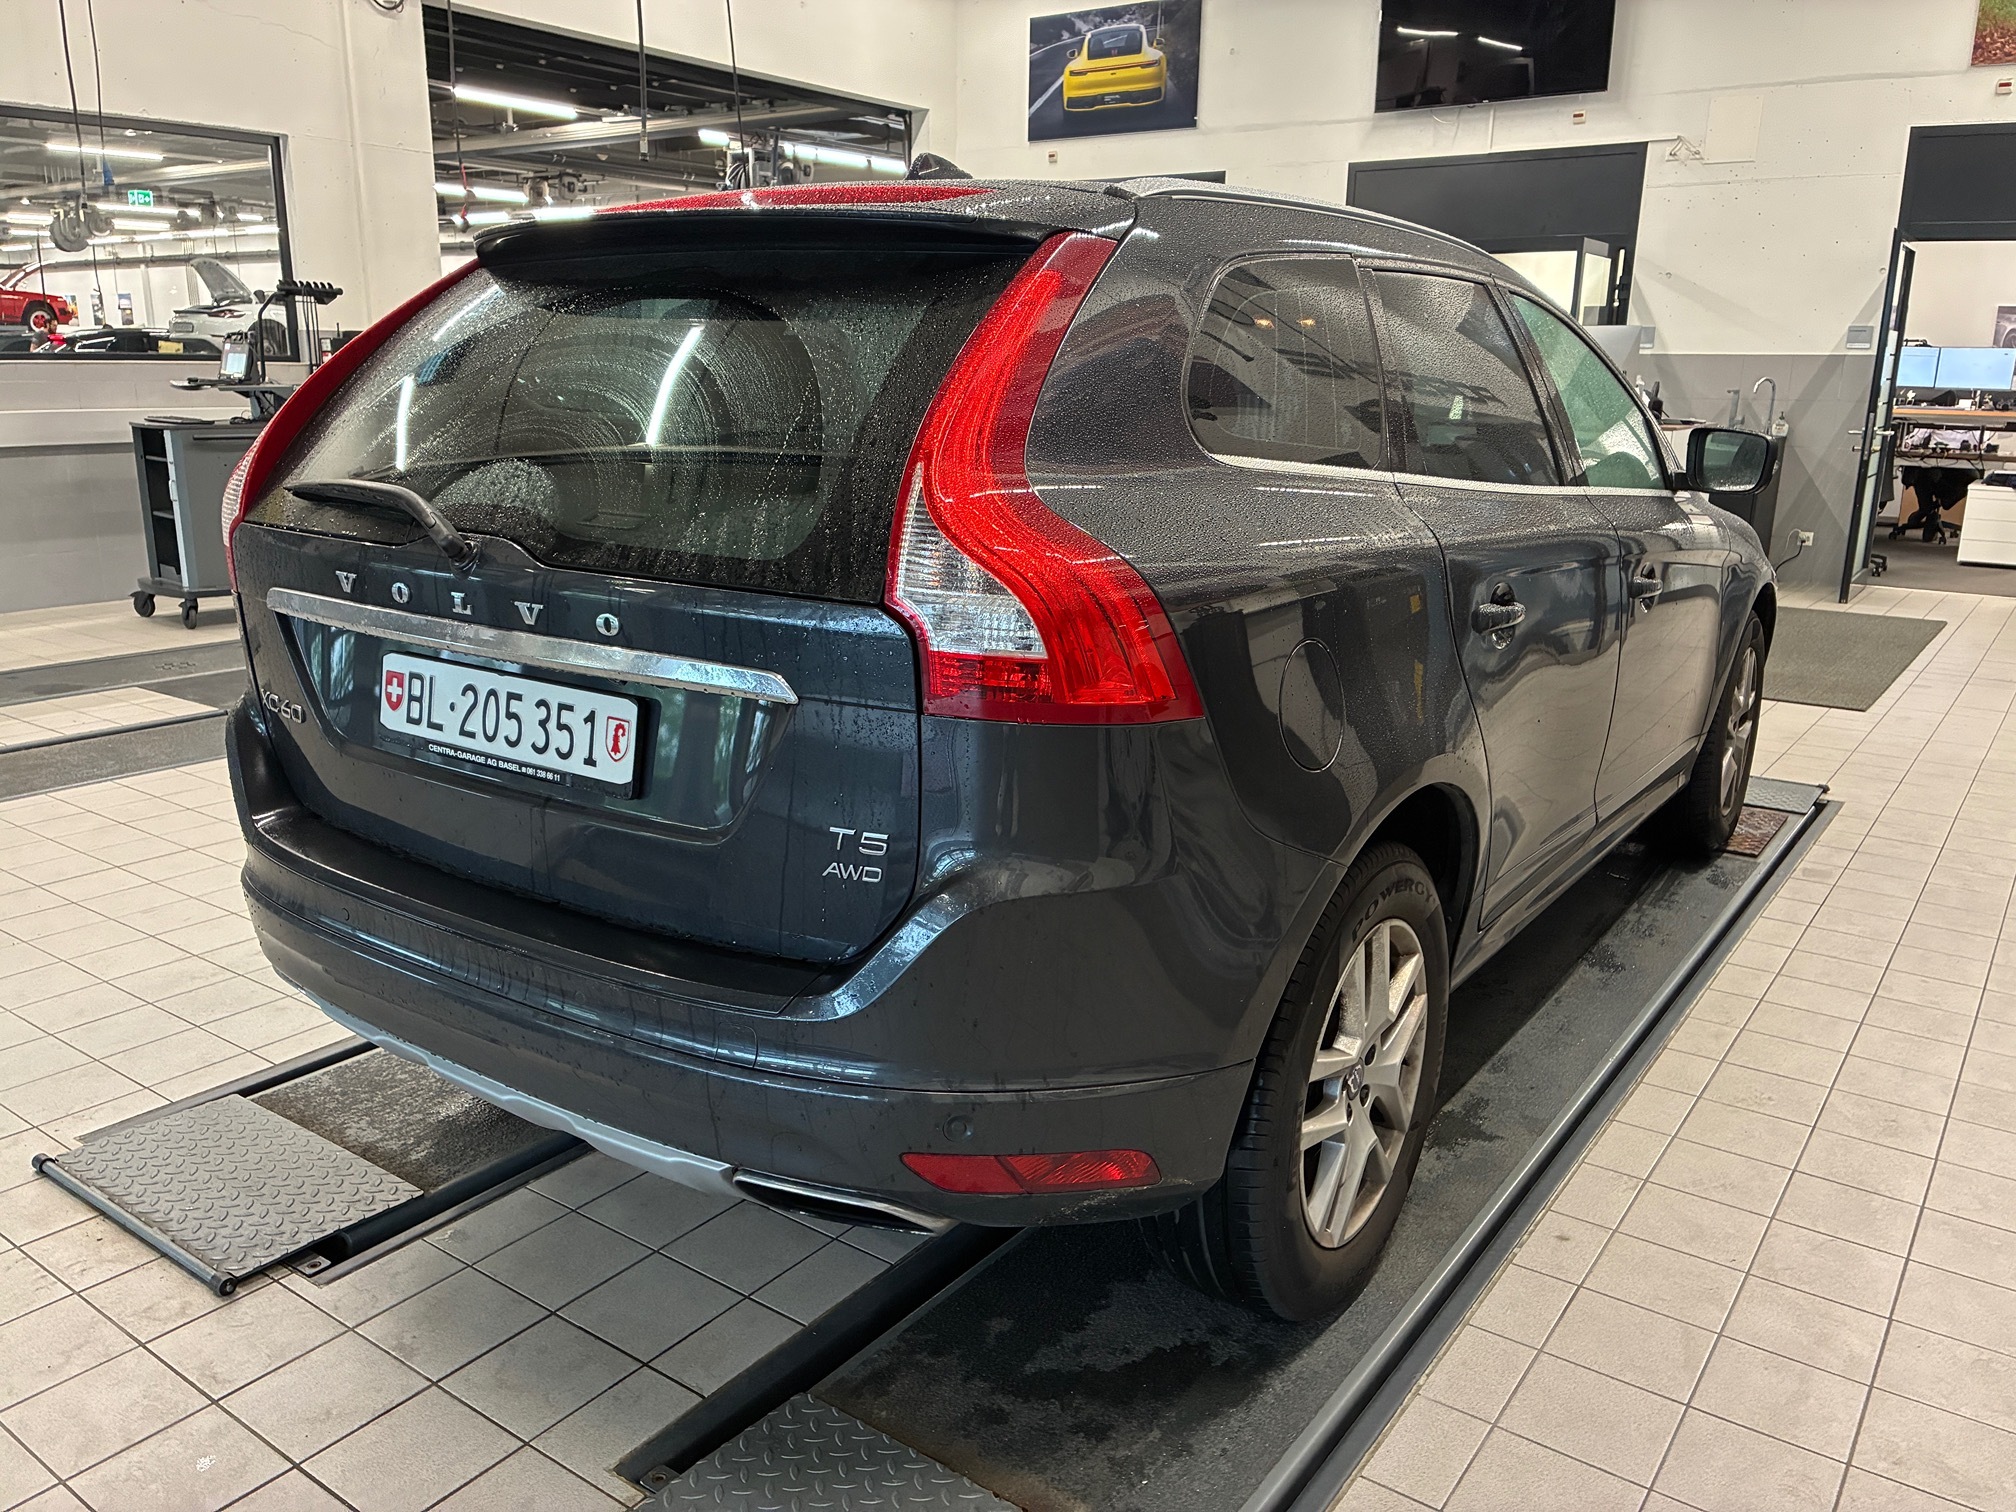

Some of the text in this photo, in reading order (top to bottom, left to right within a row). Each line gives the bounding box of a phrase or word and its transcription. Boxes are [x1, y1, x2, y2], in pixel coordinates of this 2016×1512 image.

[335, 570, 620, 637] VOLVO
[428, 743, 486, 764] CENTRA-GARAGE
[487, 757, 497, 767] AG
[498, 760, 521, 772] BASEL
[822, 862, 882, 883] AWD
